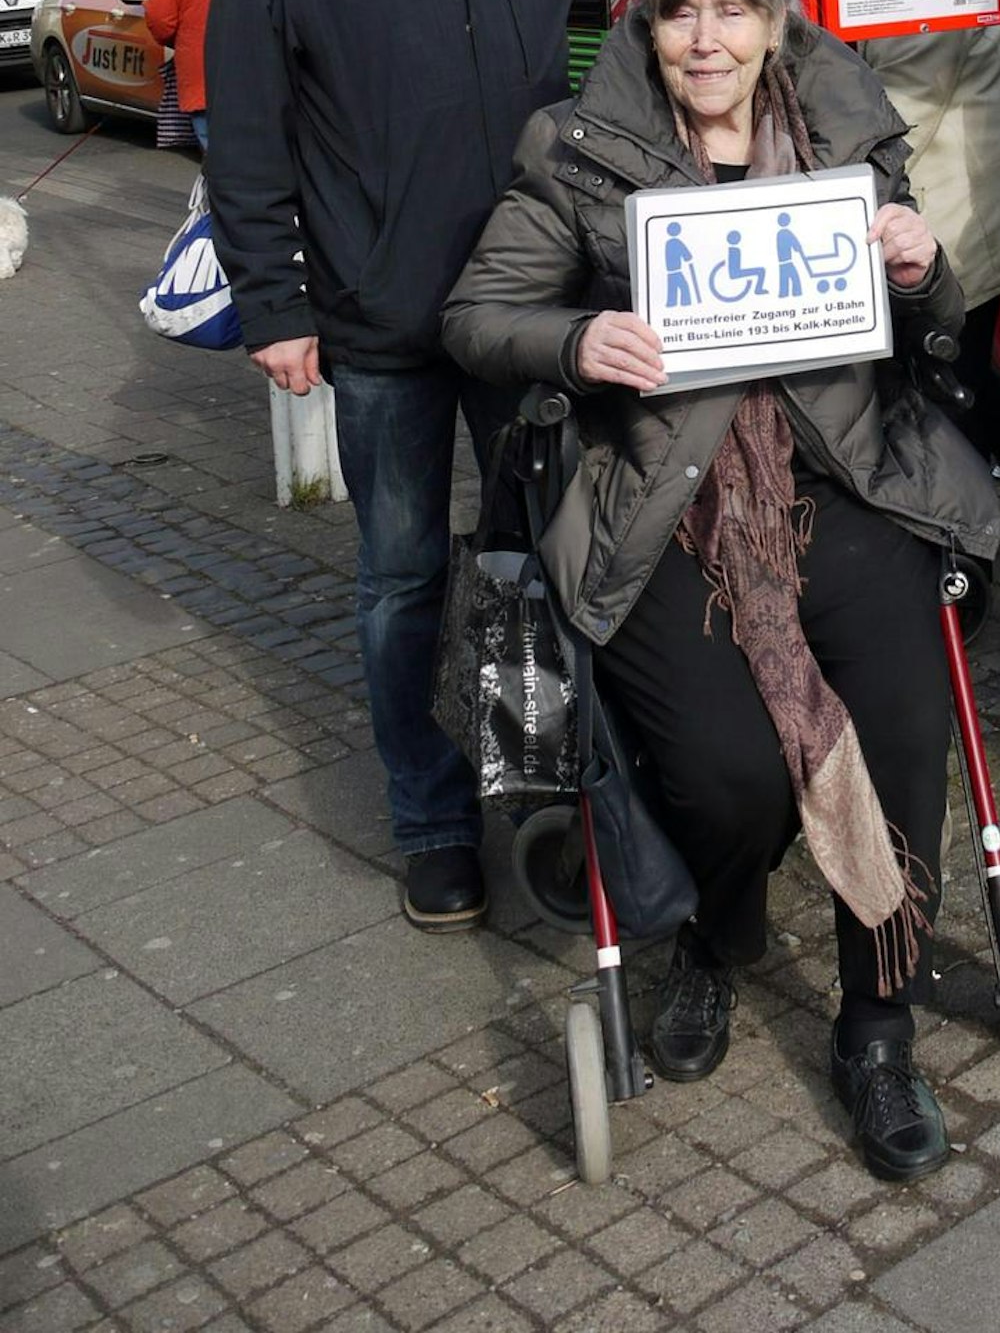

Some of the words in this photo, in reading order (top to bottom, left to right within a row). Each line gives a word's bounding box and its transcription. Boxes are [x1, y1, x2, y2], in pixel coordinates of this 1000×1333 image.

[82, 29, 118, 72] Just
[122, 45, 145, 77] Fit
[663, 312, 747, 329] Barrierefreier
[752, 307, 797, 324] Zugang
[802, 305, 820, 315] zur
[825, 299, 866, 312] U-Bahn
[663, 332, 684, 344] mit
[687, 327, 744, 342] Bus-Linie
[748, 325, 770, 336] 193
[773, 322, 791, 334] bis
[793, 314, 867, 333] Kalk-Kapelle
